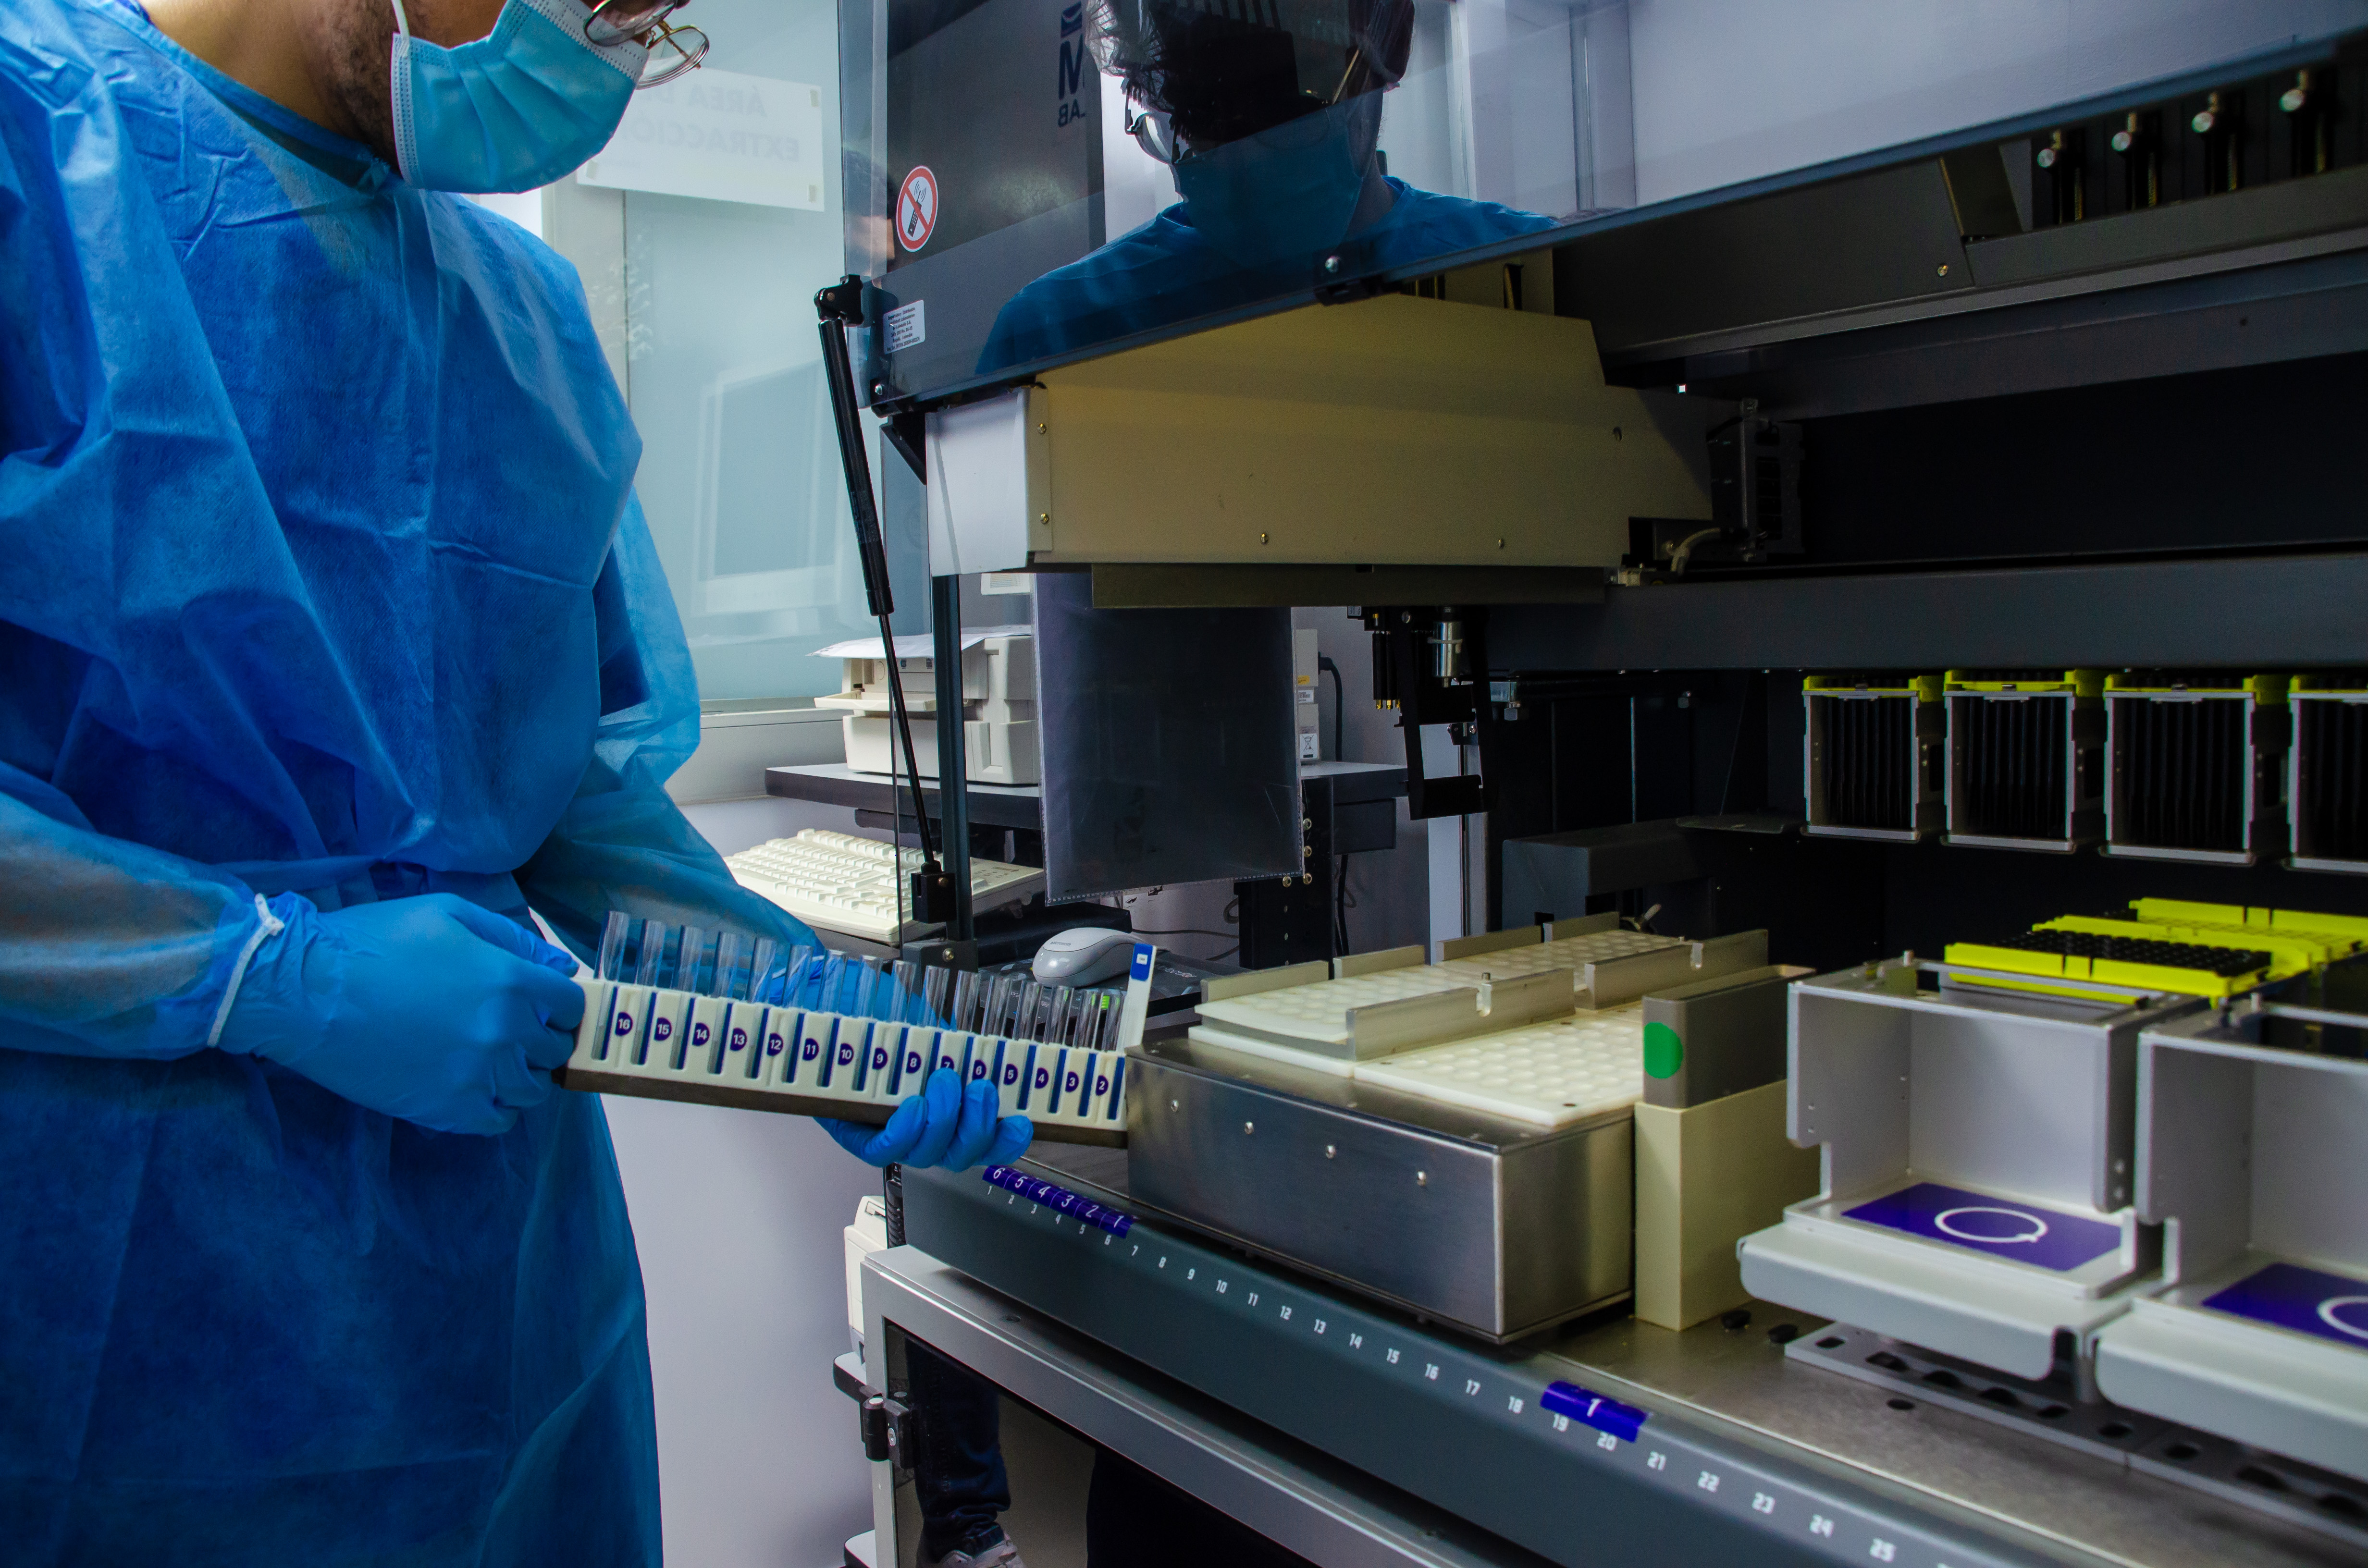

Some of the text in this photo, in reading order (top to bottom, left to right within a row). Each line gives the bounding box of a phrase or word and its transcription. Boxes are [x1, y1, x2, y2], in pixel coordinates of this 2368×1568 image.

[618, 1019, 630, 1029] 16
[658, 1024, 669, 1034] 15
[696, 1029, 708, 1040] 14
[734, 1034, 745, 1044] 13
[770, 1040, 781, 1050] 12
[806, 1044, 816, 1054] 11
[841, 1049, 852, 1059] 10
[876, 1054, 883, 1064] 9
[910, 1058, 917, 1068] 8
[975, 1066, 982, 1075] 6
[1008, 1070, 1013, 1079] 5
[1038, 1074, 1045, 1083] 4
[1069, 1078, 1075, 1086] 3
[1099, 1081, 1105, 1090] 2
[993, 1167, 1124, 1228] 6 5 4 3 2 1
[987, 1186, 1896, 1562] 1 2 3 4 5 6 7 8 9 10 11 12 13 14 15 16 17 18 19 20 21 22 23 24 25
[1587, 1397, 1601, 1417] 1
